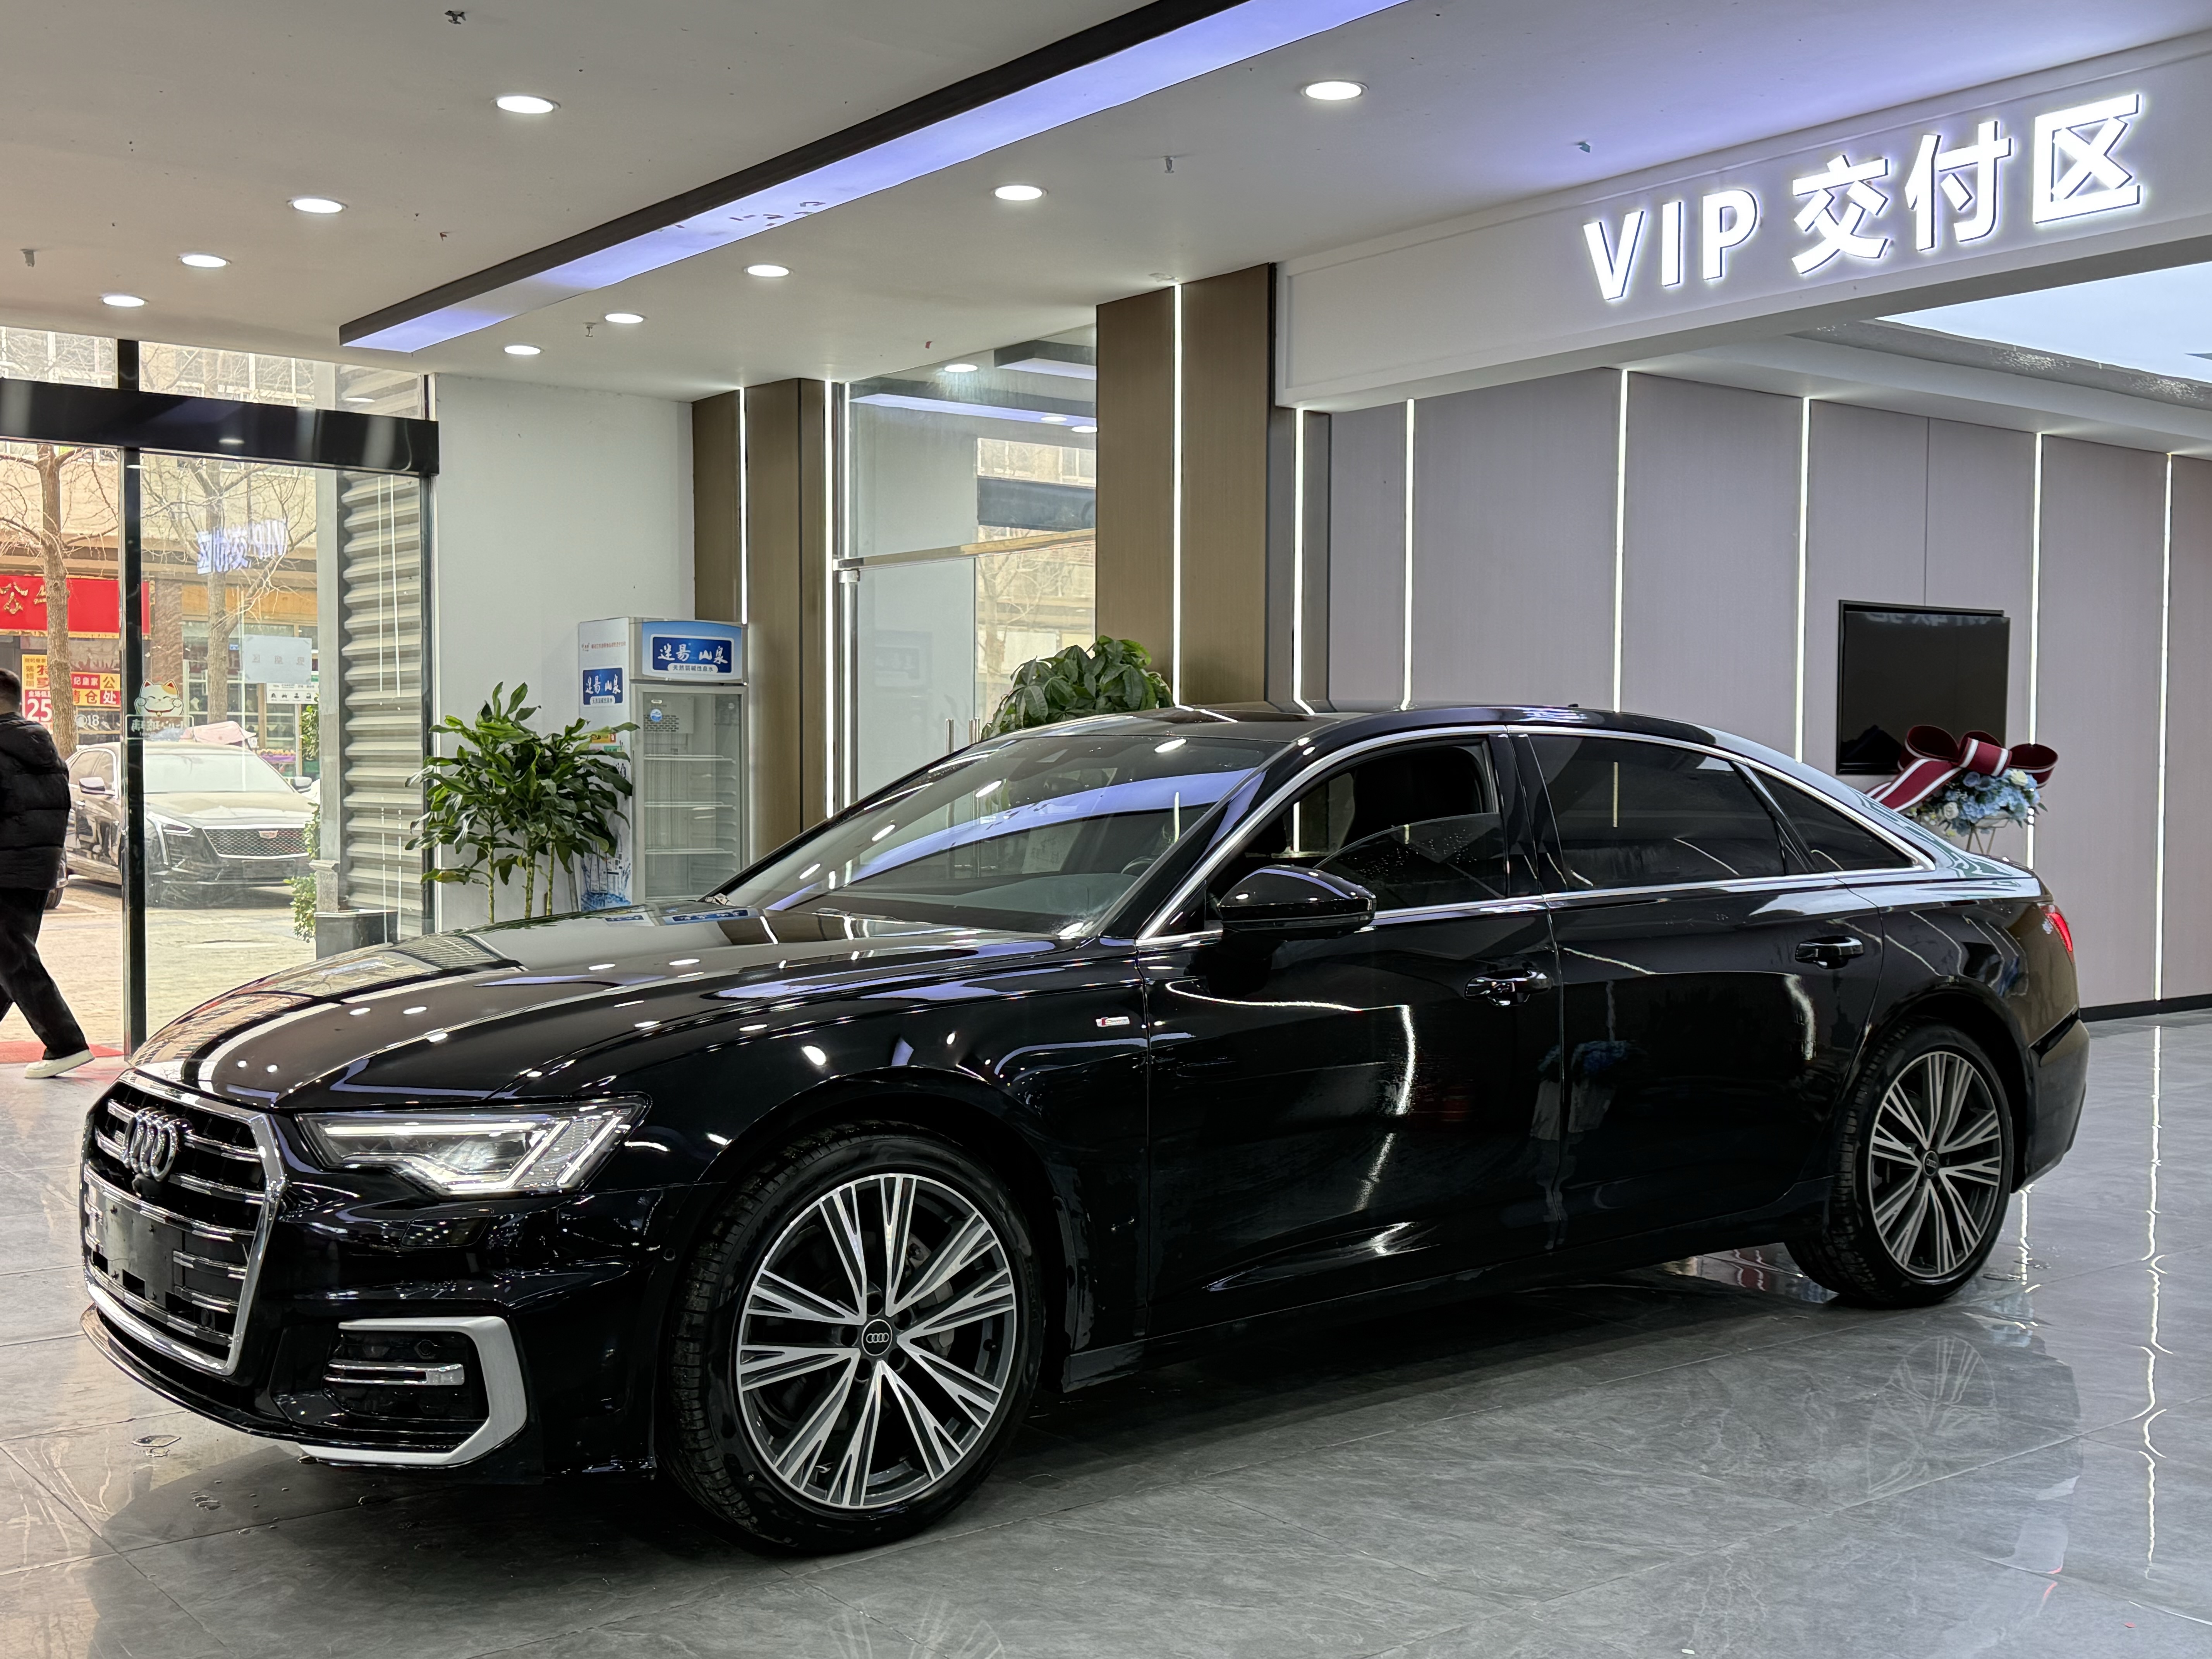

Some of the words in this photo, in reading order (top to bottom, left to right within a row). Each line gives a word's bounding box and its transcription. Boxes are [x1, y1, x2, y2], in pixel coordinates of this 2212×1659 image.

[1583, 188, 1760, 301] VIP
[1791, 93, 2140, 275] 交付区
